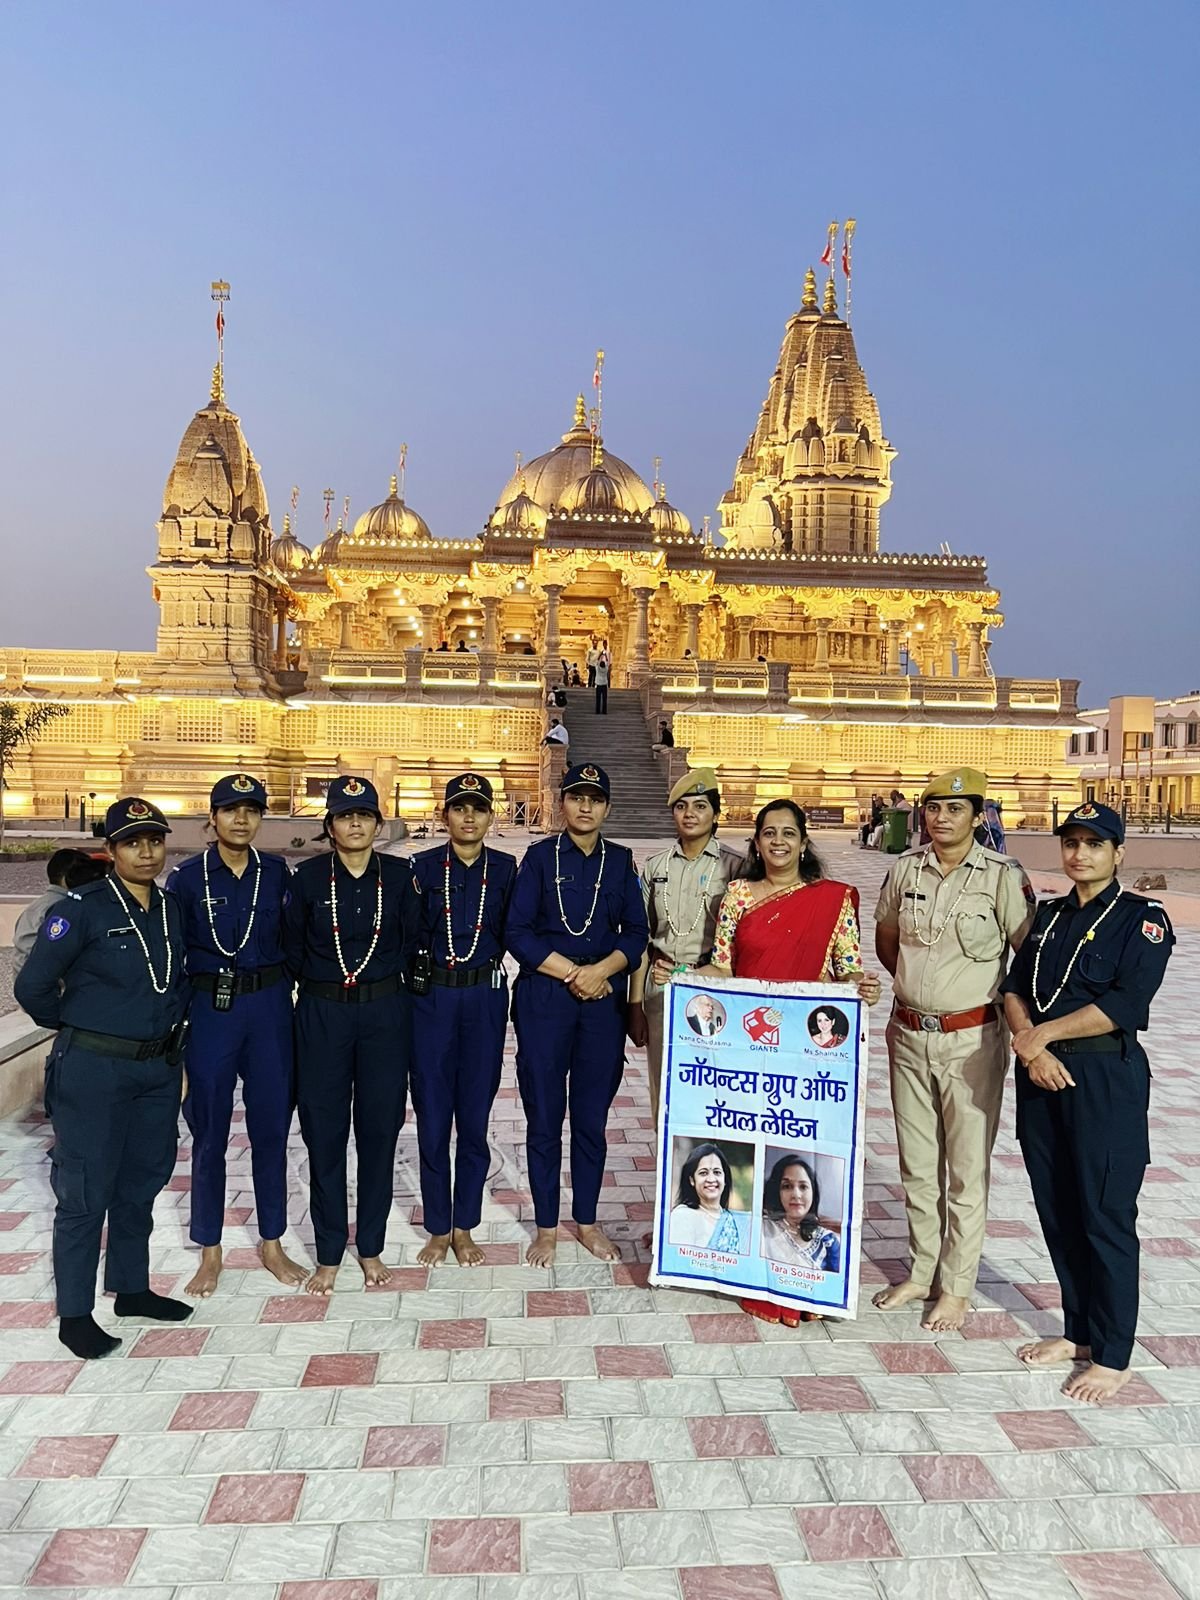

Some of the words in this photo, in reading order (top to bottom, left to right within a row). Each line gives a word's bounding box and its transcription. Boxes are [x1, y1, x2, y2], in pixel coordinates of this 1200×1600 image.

[750, 1044, 778, 1053] GIANTS
[678, 1056, 759, 1094] जॉयन्टस
[762, 1073, 798, 1106] ग्रुप
[800, 1071, 848, 1103] ऑफ
[705, 1099, 758, 1132] रॉयल
[761, 1108, 819, 1141] लेडिज
[679, 1247, 709, 1259] Nirupa
[711, 1252, 738, 1265] Patwa
[691, 1259, 725, 1272] President
[771, 1262, 788, 1274] Tara
[790, 1267, 825, 1281] Solanki
[778, 1276, 814, 1291] Secretary
